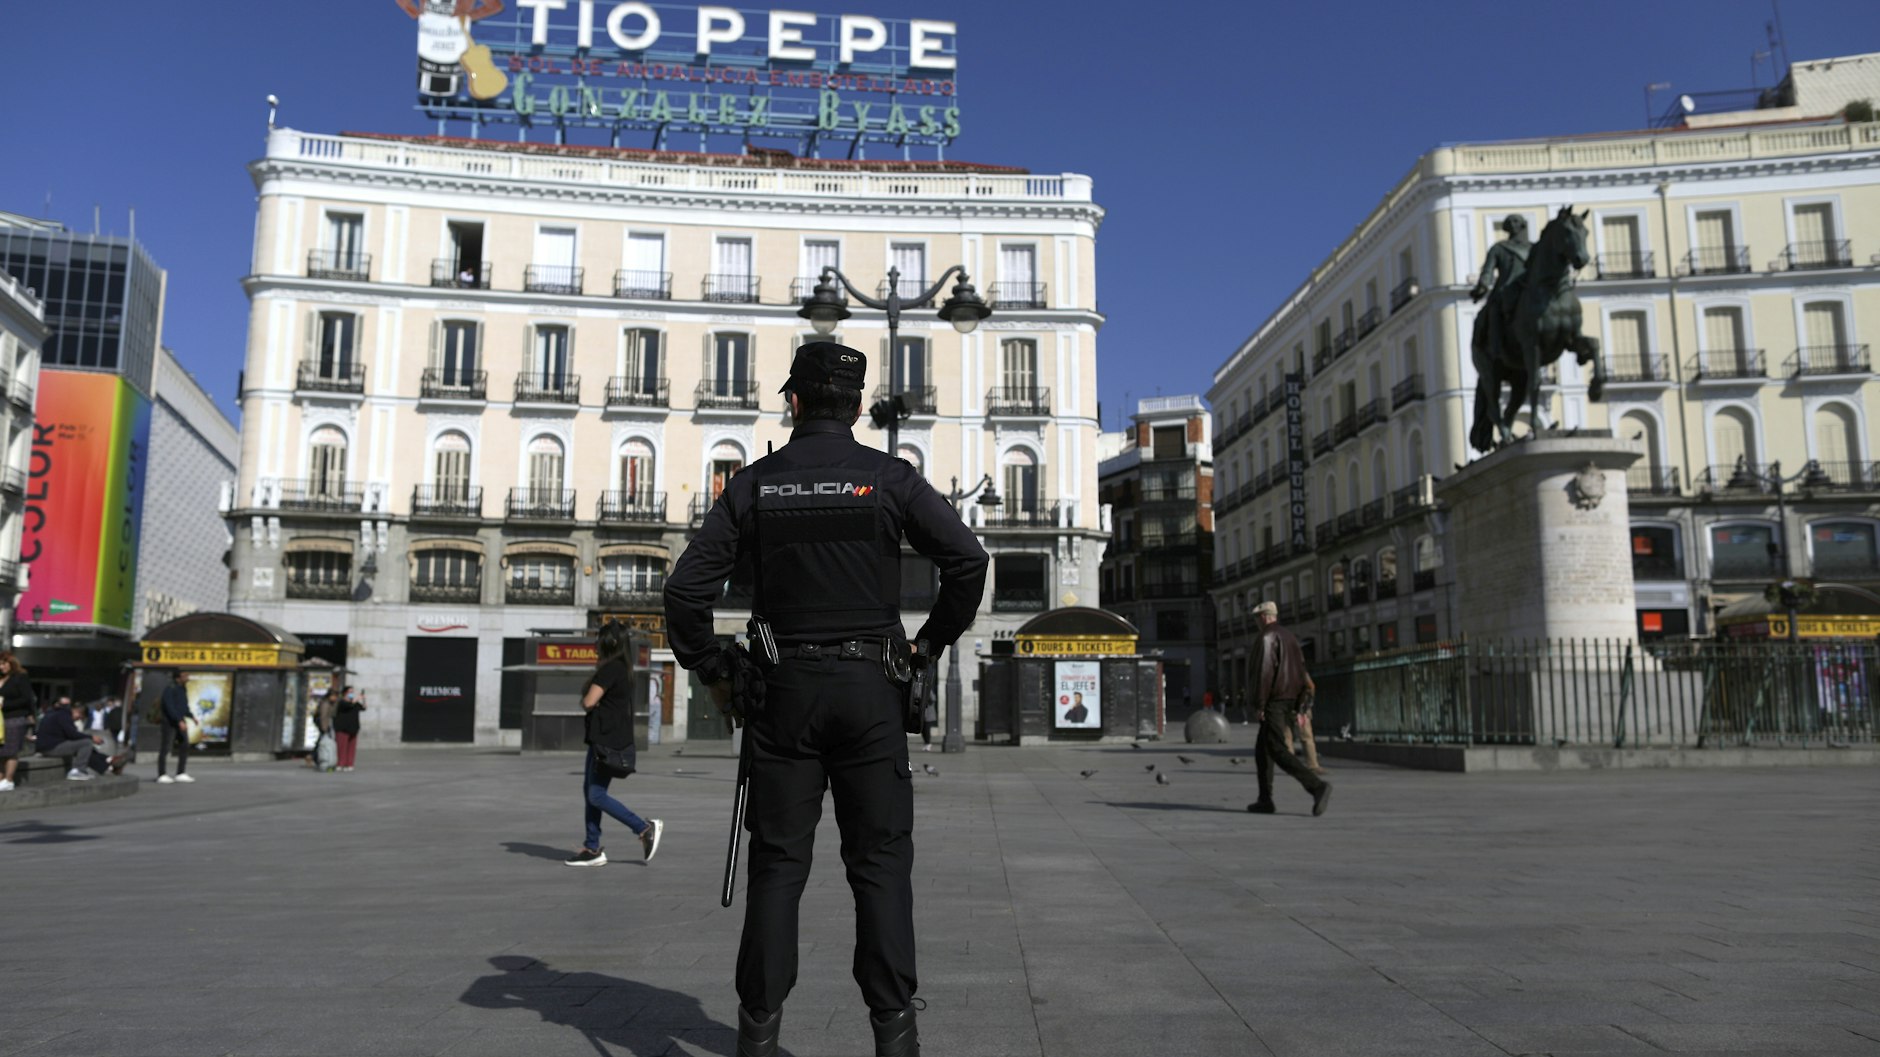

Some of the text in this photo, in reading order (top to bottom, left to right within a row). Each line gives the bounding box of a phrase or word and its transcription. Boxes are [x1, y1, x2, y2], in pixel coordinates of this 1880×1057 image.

[516, 0, 957, 69] TIO PEPE
[508, 56, 955, 95] SOL DE ANDALUCIA EMBOTELLADO
[840, 354, 859, 363] CNP
[1287, 381, 1305, 545] HOTEL EUROPA
[759, 482, 857, 498] POLICIA
[418, 615, 468, 625] PRIMOR
[1832, 623, 1871, 633] TICKETS
[1036, 642, 1063, 652] TOURS
[1066, 642, 1073, 652] &
[1077, 642, 1113, 652] TICKETS
[163, 650, 196, 661] TOURS
[200, 650, 207, 661] &
[210, 650, 253, 662] TICKETS
[565, 648, 598, 659] TABA
[420, 686, 461, 697] PRIMOR
[1061, 681, 1088, 691] EL JEFE
